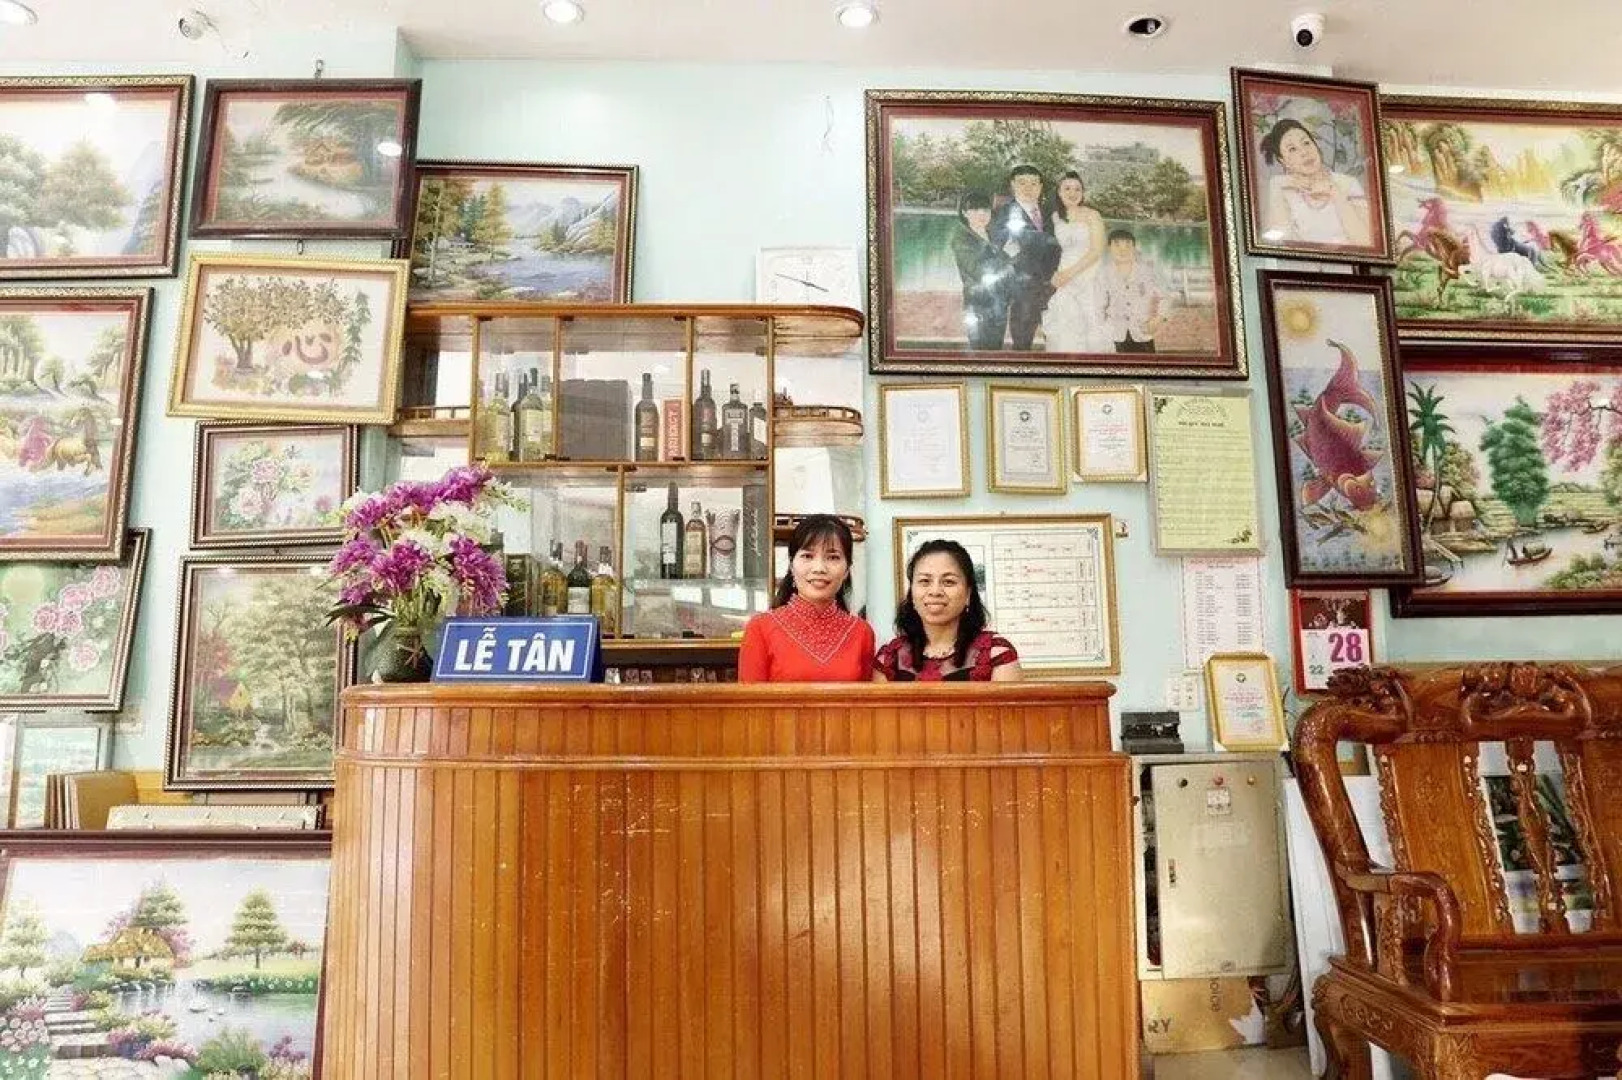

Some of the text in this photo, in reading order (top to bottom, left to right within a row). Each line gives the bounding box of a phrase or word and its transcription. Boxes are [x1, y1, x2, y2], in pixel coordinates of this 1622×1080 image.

[454, 627, 575, 672] LỄ TÂN
[1328, 632, 1362, 662] 28
[1309, 664, 1324, 675] 22
